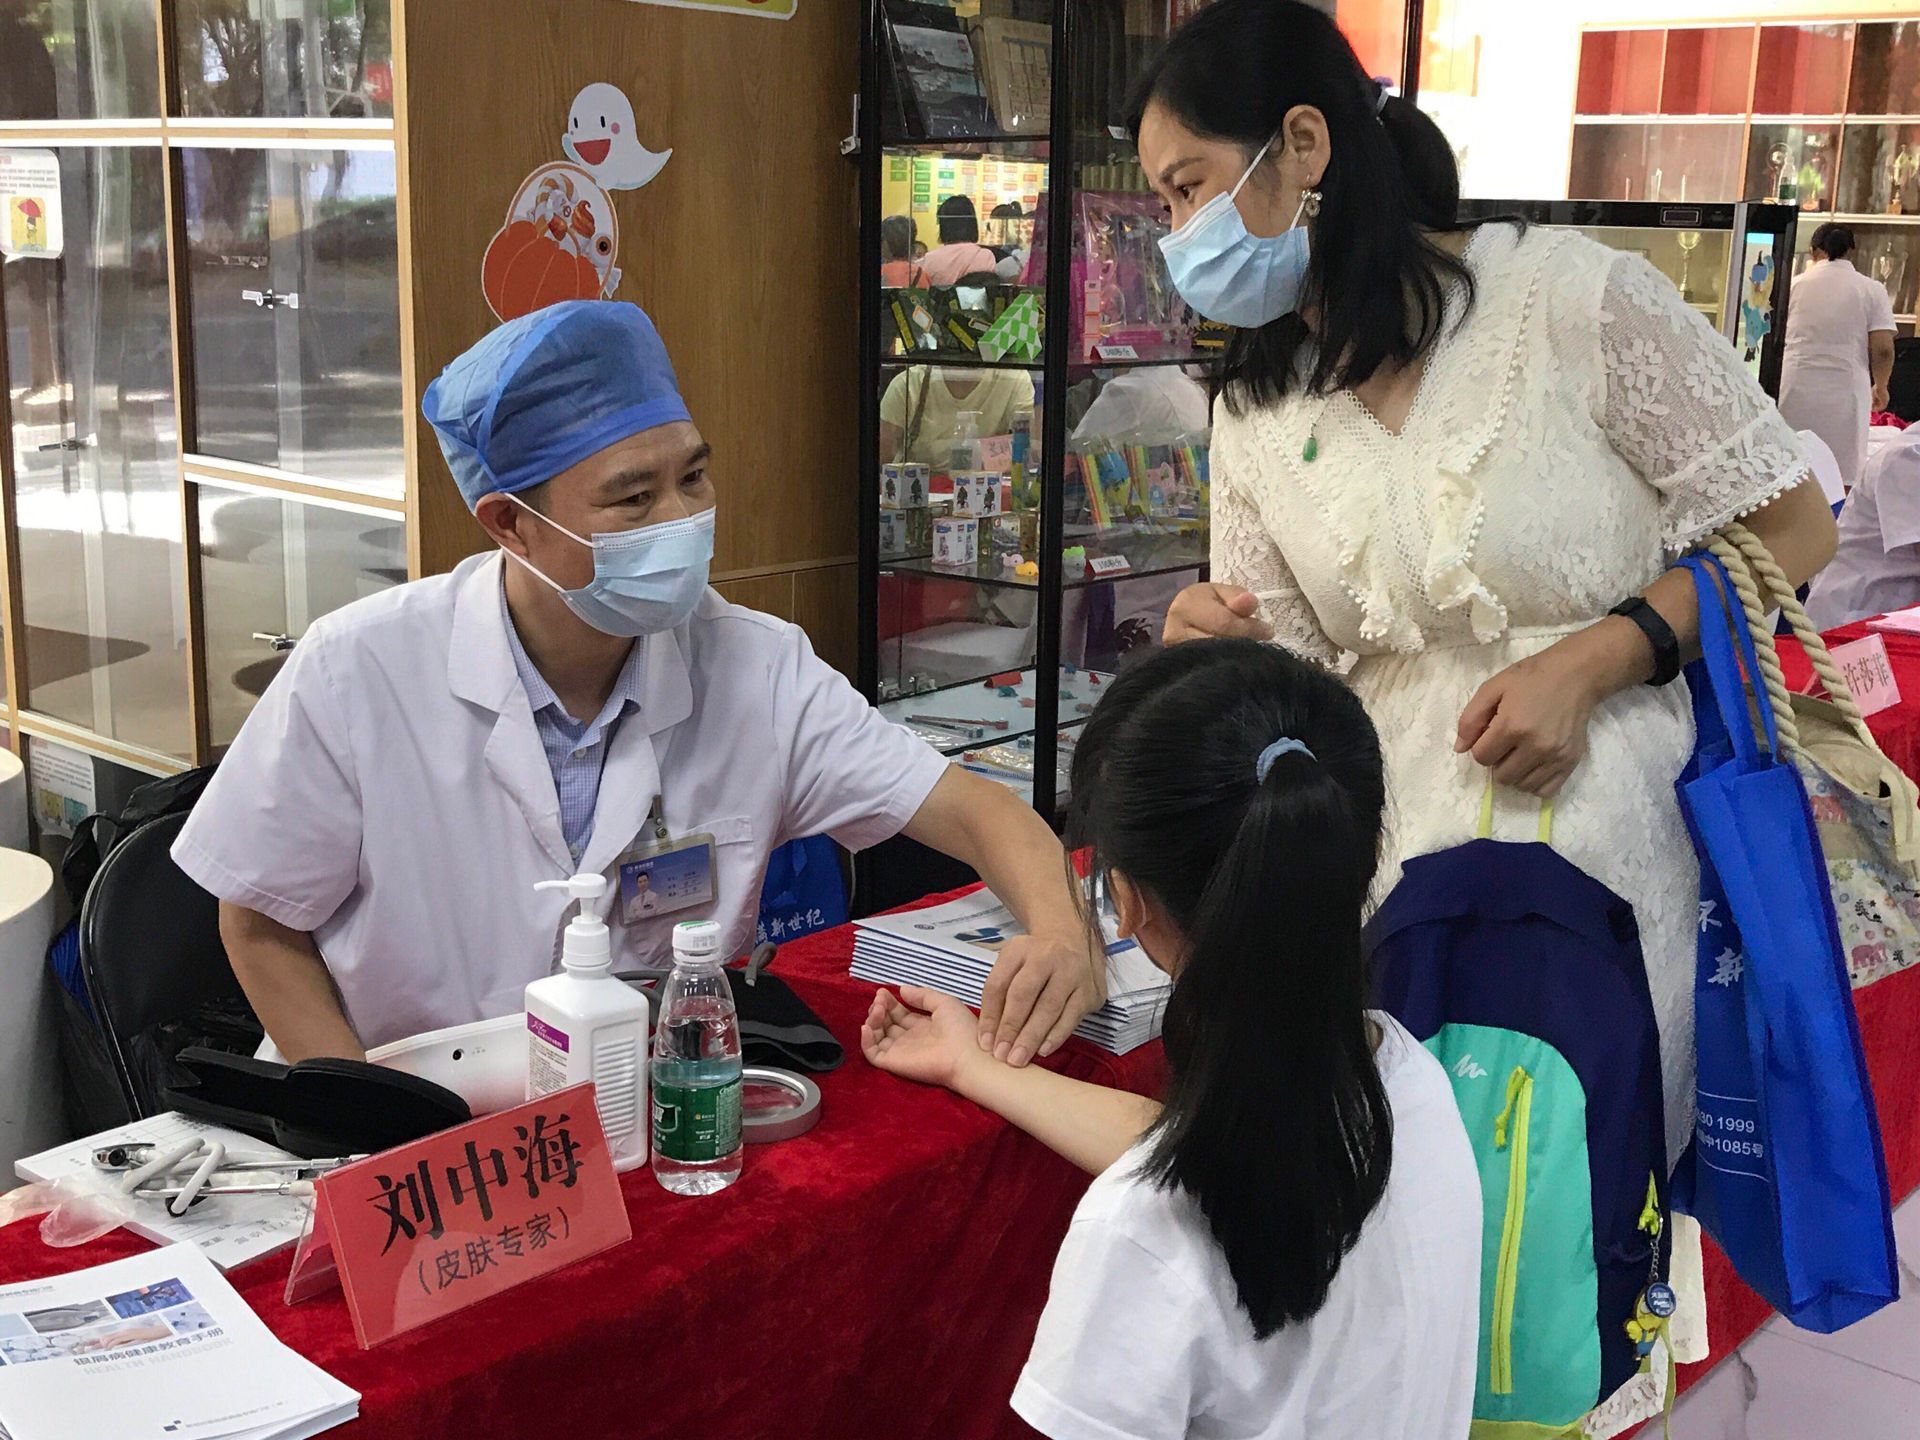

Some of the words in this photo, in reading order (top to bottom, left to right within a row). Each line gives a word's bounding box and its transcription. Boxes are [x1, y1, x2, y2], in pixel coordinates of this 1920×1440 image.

[1717, 1115, 1755, 1133] 1999
[367, 1114, 584, 1257] 刘中海
[418, 1206, 569, 1295] （皮肤专家）
